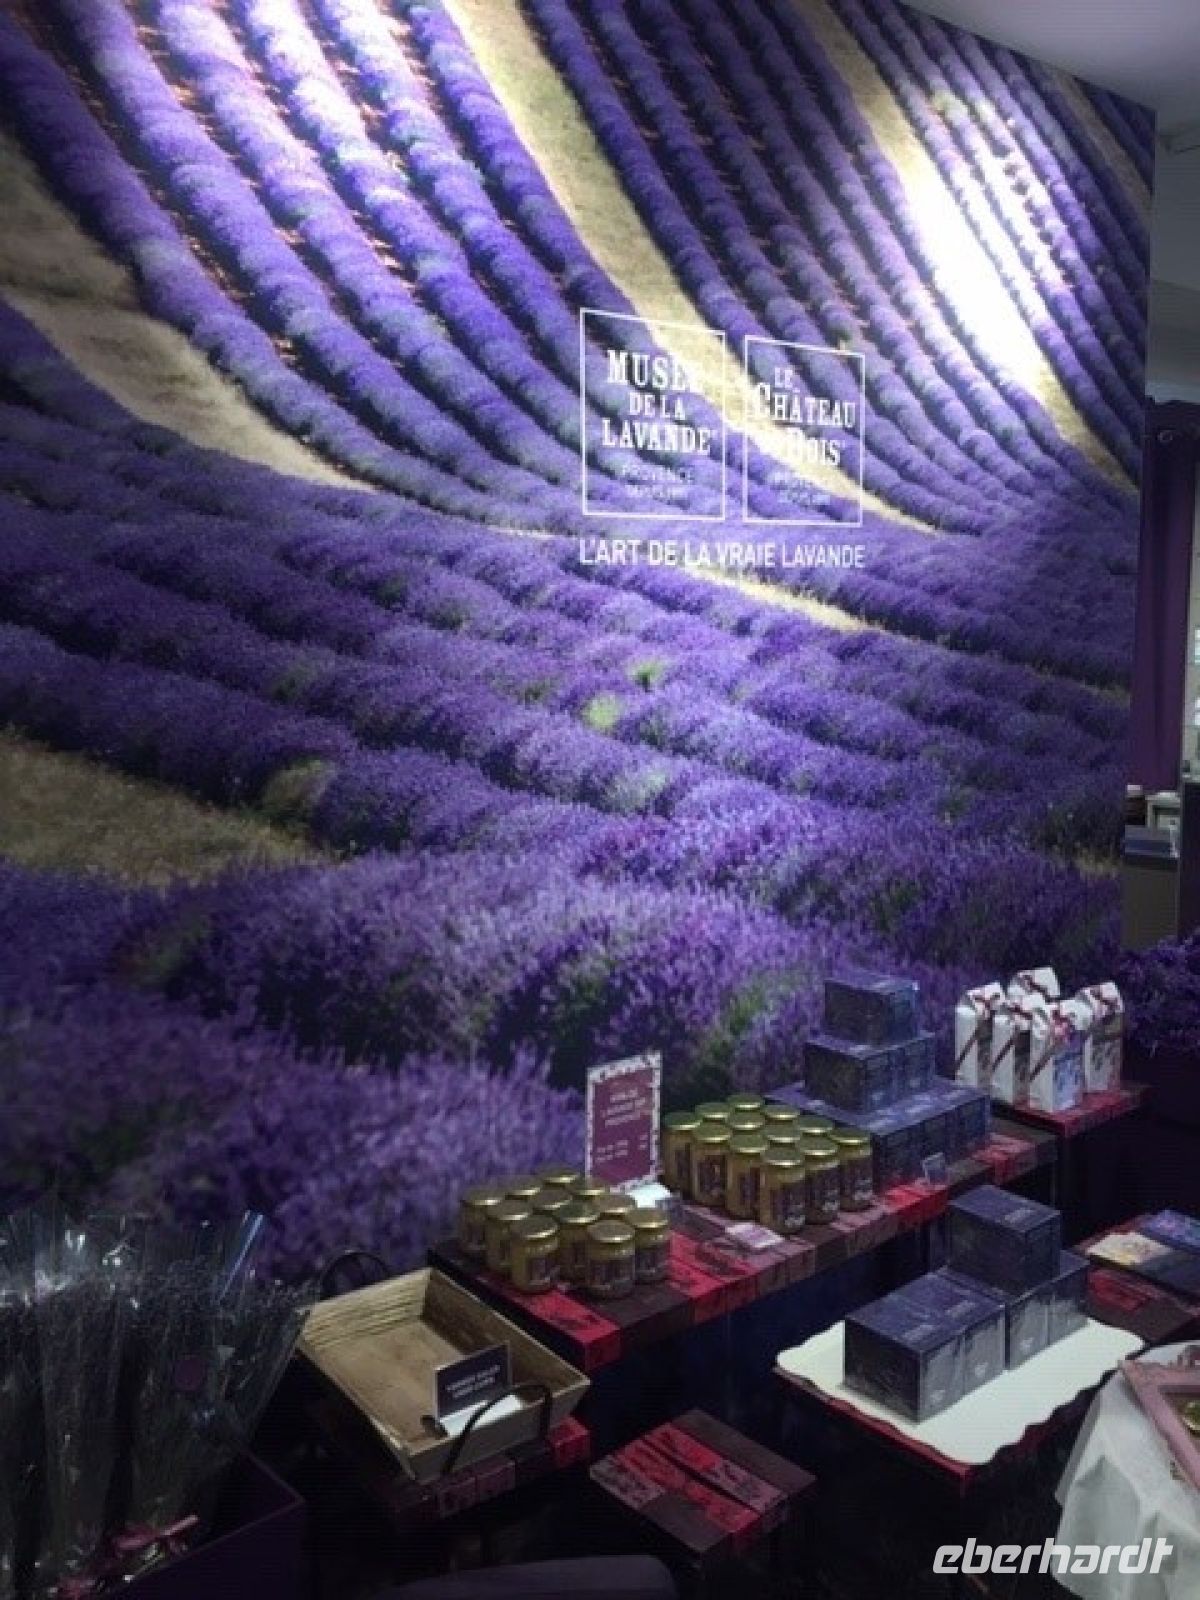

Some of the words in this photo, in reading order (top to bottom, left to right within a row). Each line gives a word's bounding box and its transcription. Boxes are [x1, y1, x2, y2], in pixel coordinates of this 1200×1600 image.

[774, 366, 794, 388] LE
[628, 392, 656, 417] DE
[660, 394, 686, 420] LA
[601, 417, 711, 456] LAVANDE
[579, 536, 641, 567] L'ART
[648, 539, 678, 567] DE
[684, 541, 711, 567] LA
[714, 541, 776, 568] VRAIE
[781, 543, 866, 569] LAVANDE
